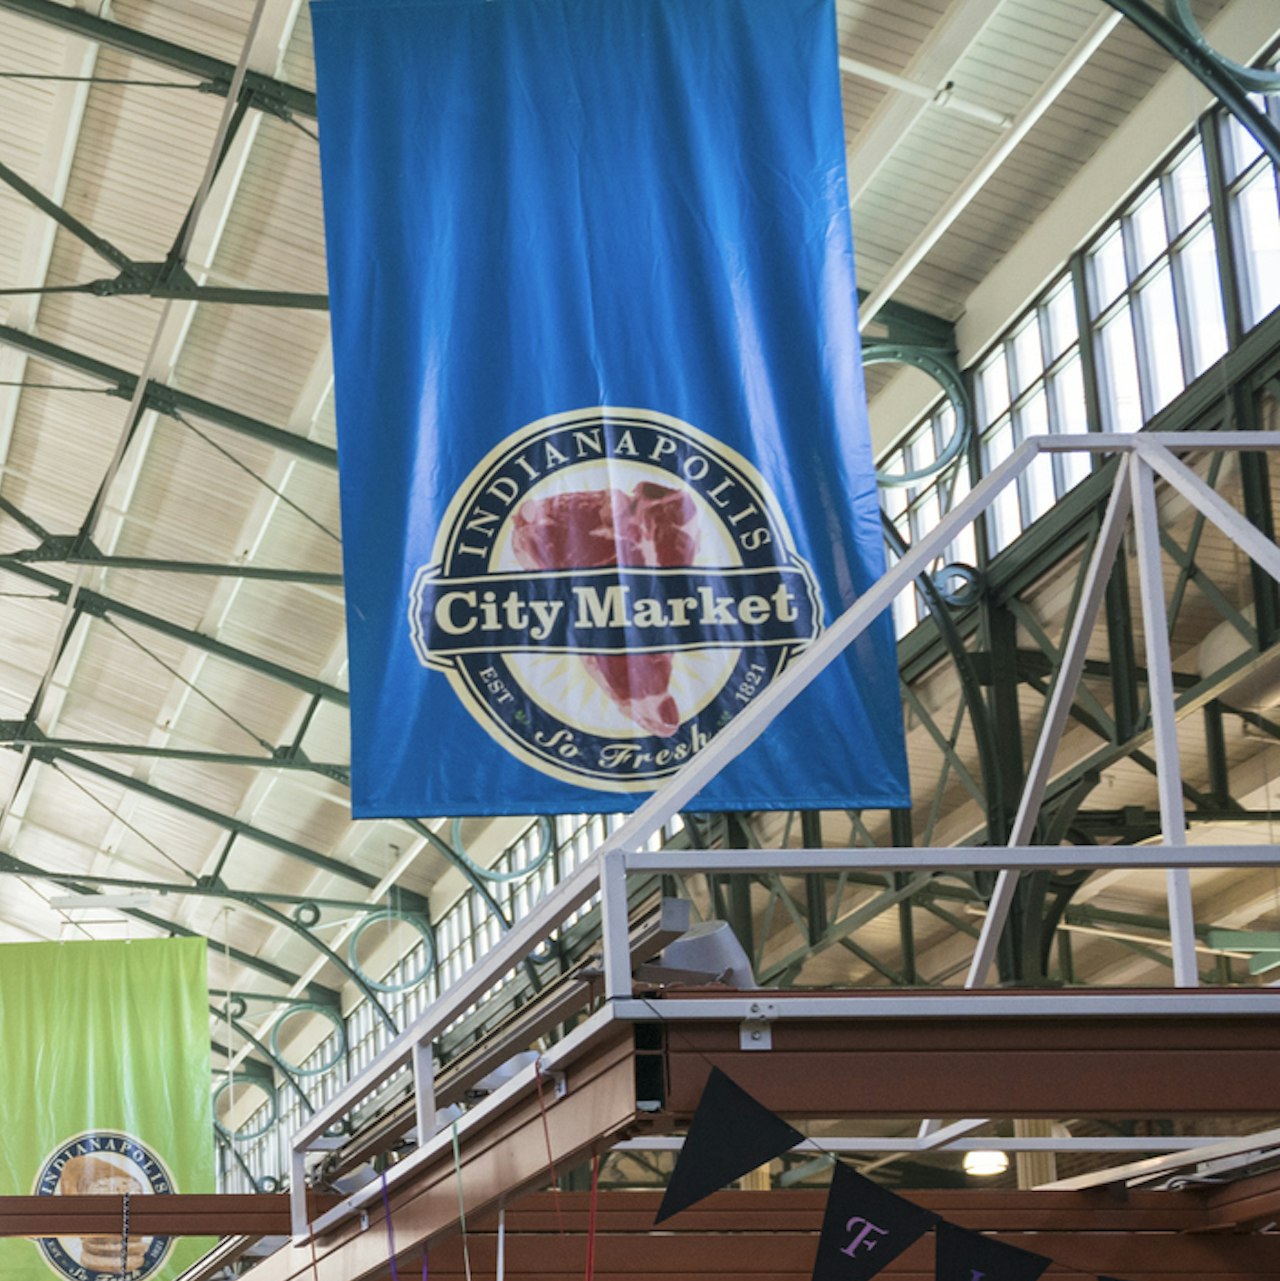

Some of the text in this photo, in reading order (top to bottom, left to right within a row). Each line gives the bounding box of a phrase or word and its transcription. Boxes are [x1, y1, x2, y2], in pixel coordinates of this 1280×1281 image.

[458, 428, 771, 560] INDIANAPOLIS
[434, 583, 799, 640] City Market
[479, 666, 515, 706] EST
[734, 662, 768, 705] 1821
[535, 724, 714, 772] So Fresh
[41, 1138, 168, 1195] INDIANAPOLIS
